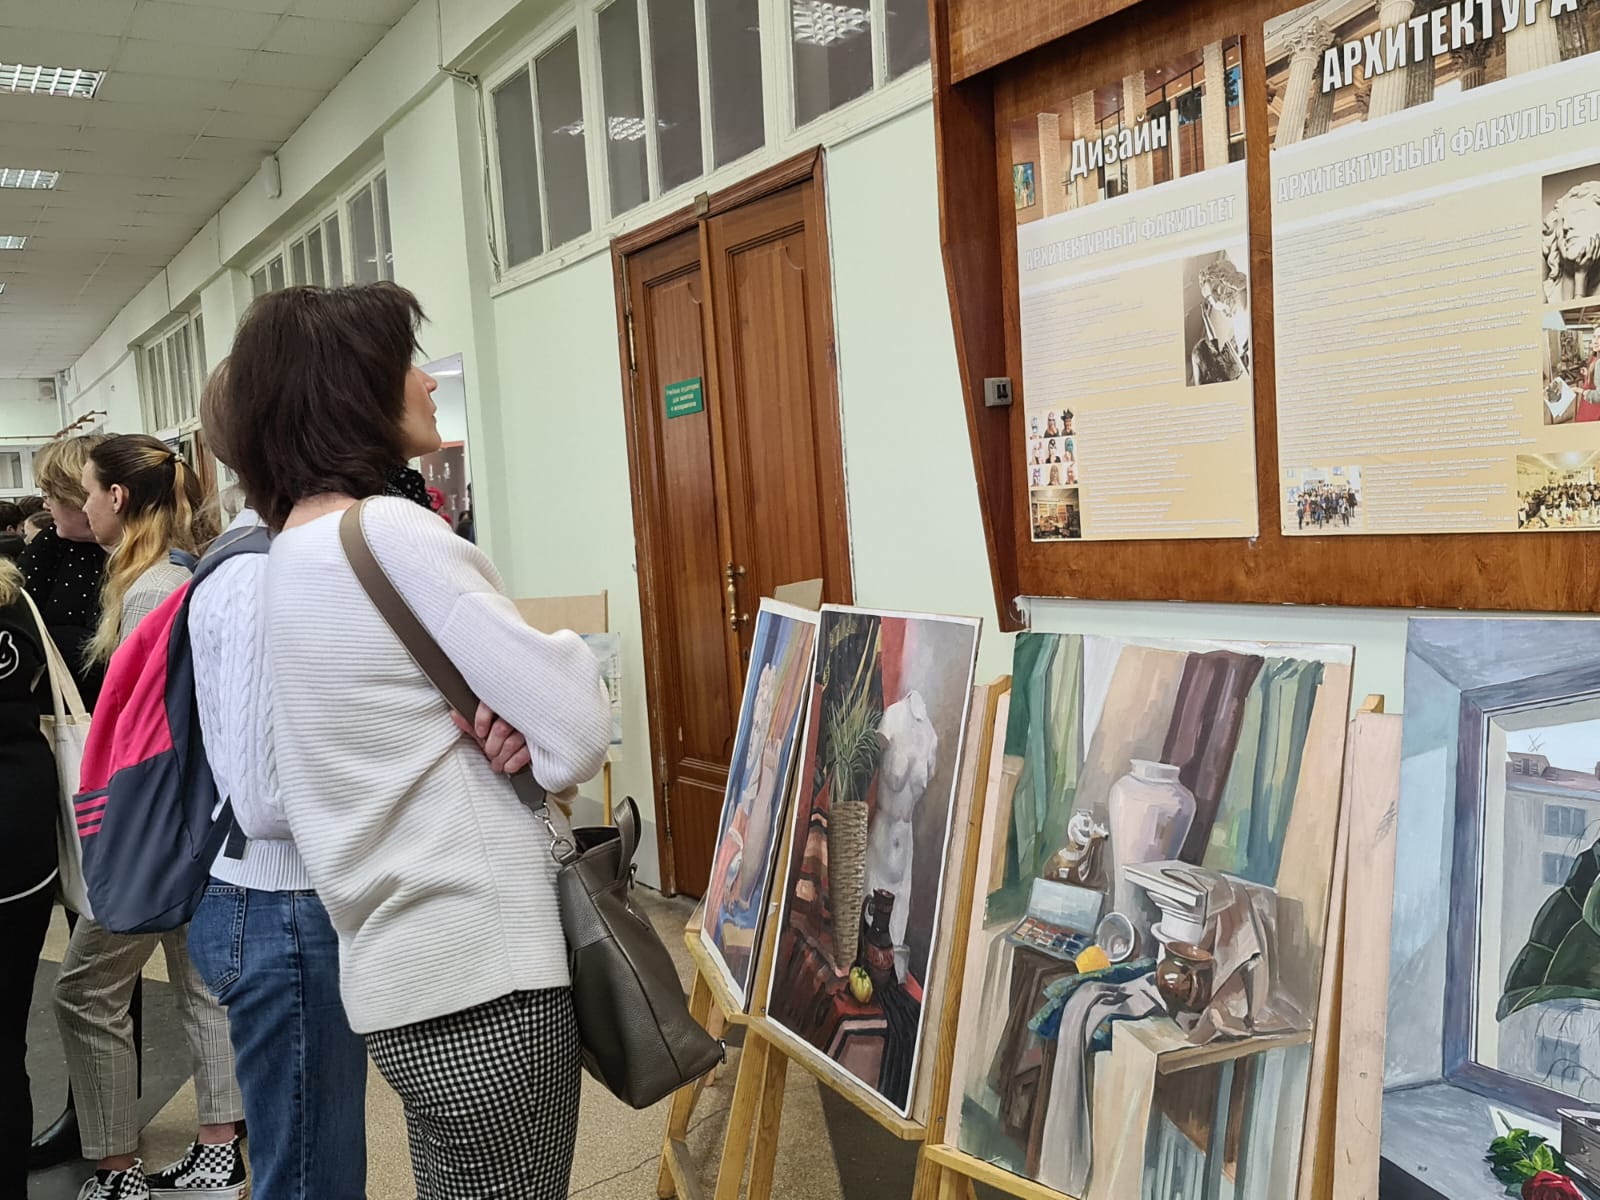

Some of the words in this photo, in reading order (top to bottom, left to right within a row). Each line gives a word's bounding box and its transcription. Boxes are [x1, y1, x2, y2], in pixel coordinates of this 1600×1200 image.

[1070, 114, 1168, 182] Дизайн
[1276, 128, 1446, 203] АРХИТЕКТУРНЫЙ
[1450, 89, 1600, 156] ФАКУЛЬТЕТ
[1025, 217, 1137, 271] АРХИТЕКТУРНЫЙ
[1140, 195, 1236, 240] ФАКУЛЬТЕТ
